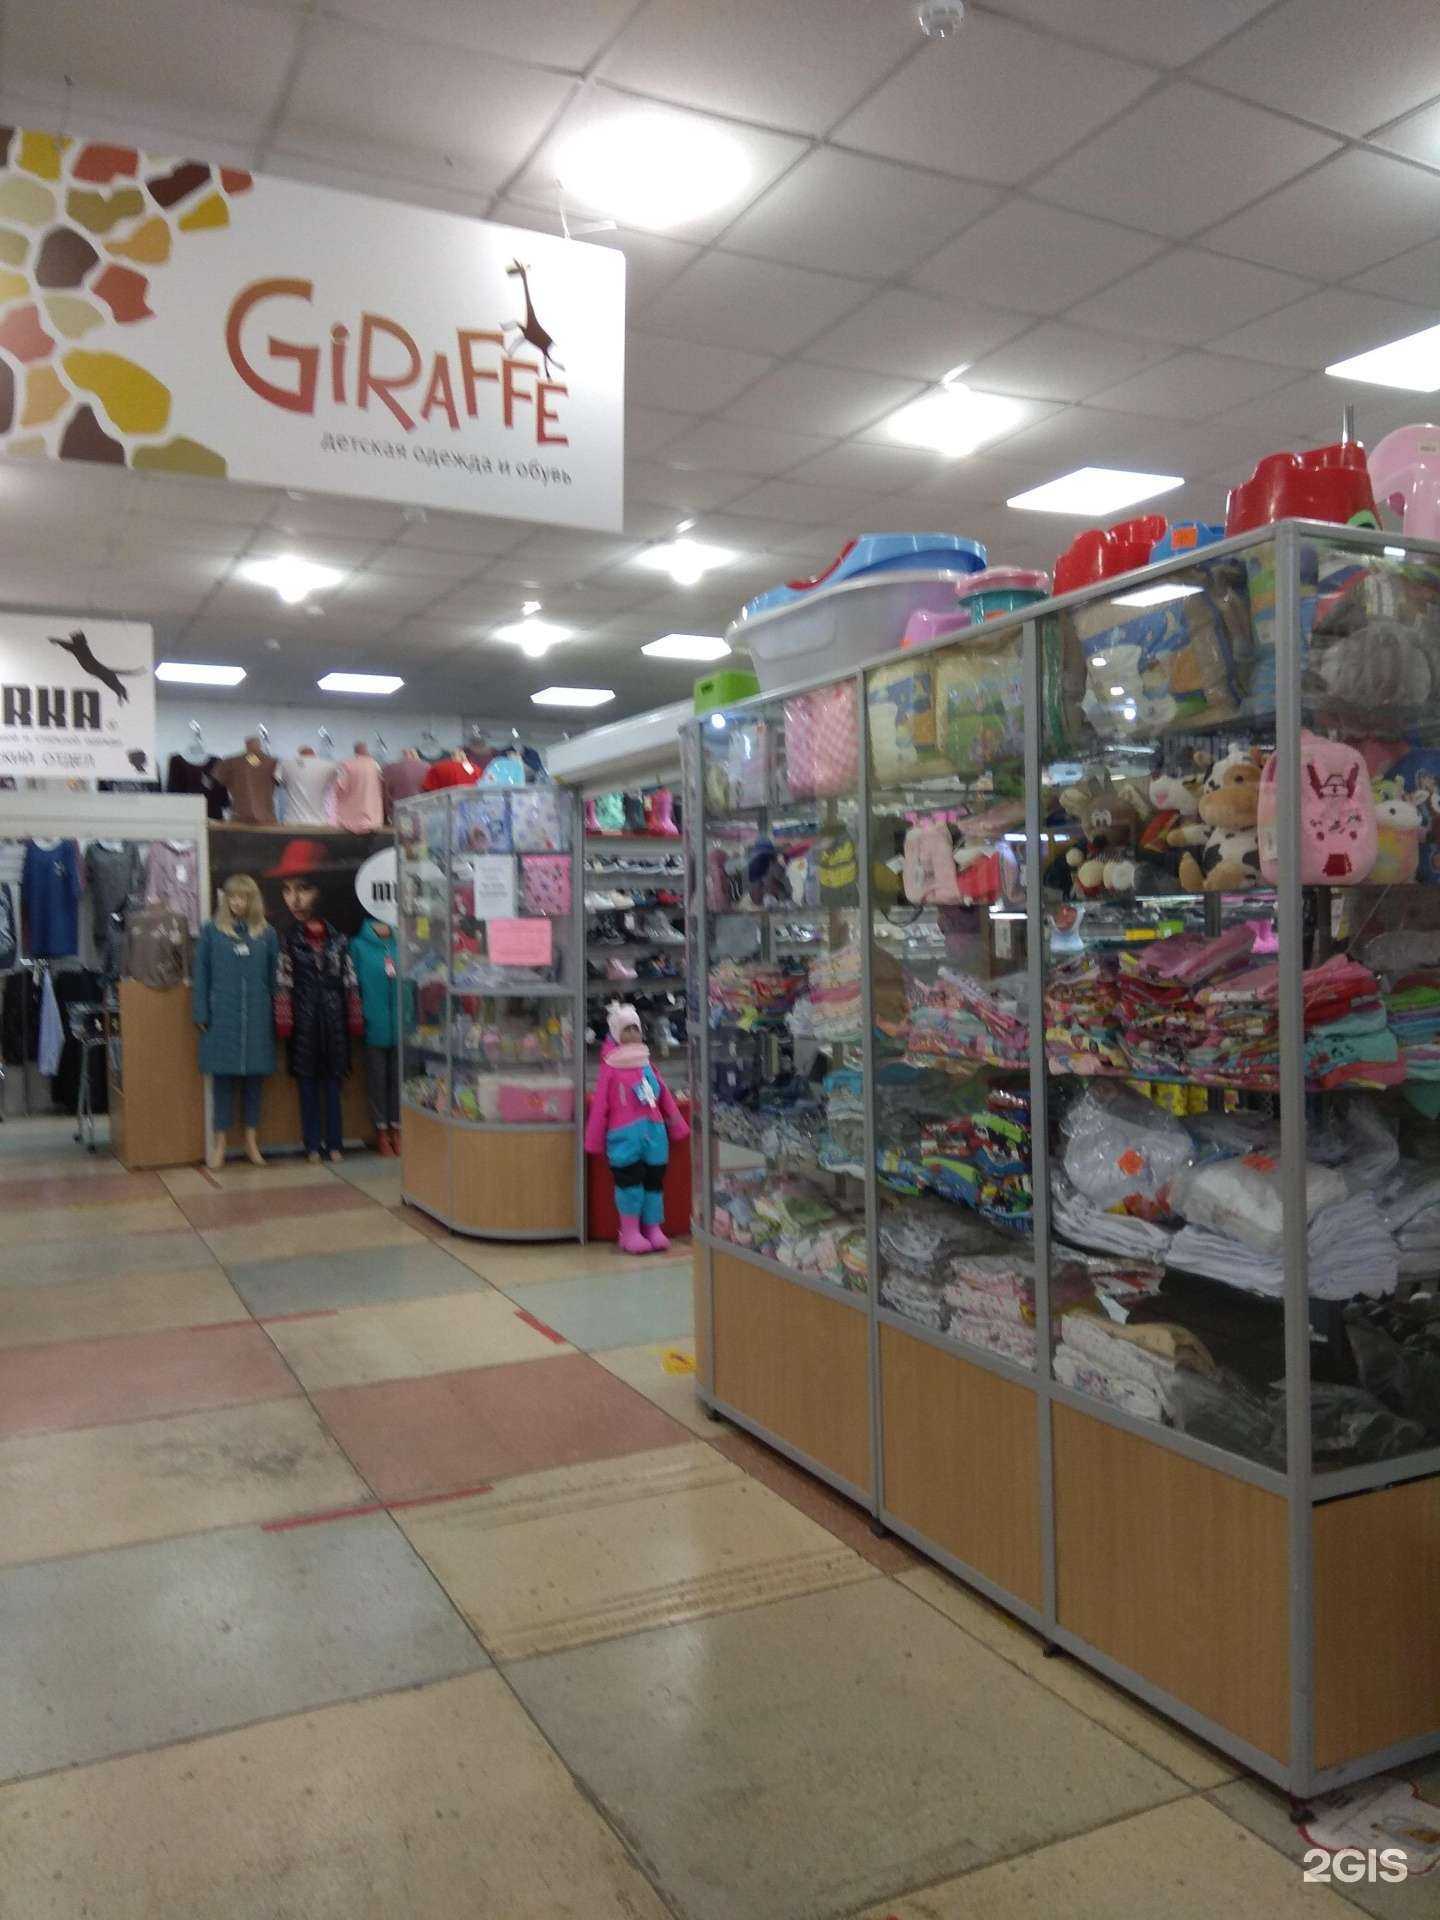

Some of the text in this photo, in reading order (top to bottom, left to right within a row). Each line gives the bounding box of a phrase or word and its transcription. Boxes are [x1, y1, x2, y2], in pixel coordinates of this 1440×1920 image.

[320, 431, 572, 487] детская одежда и обувь
